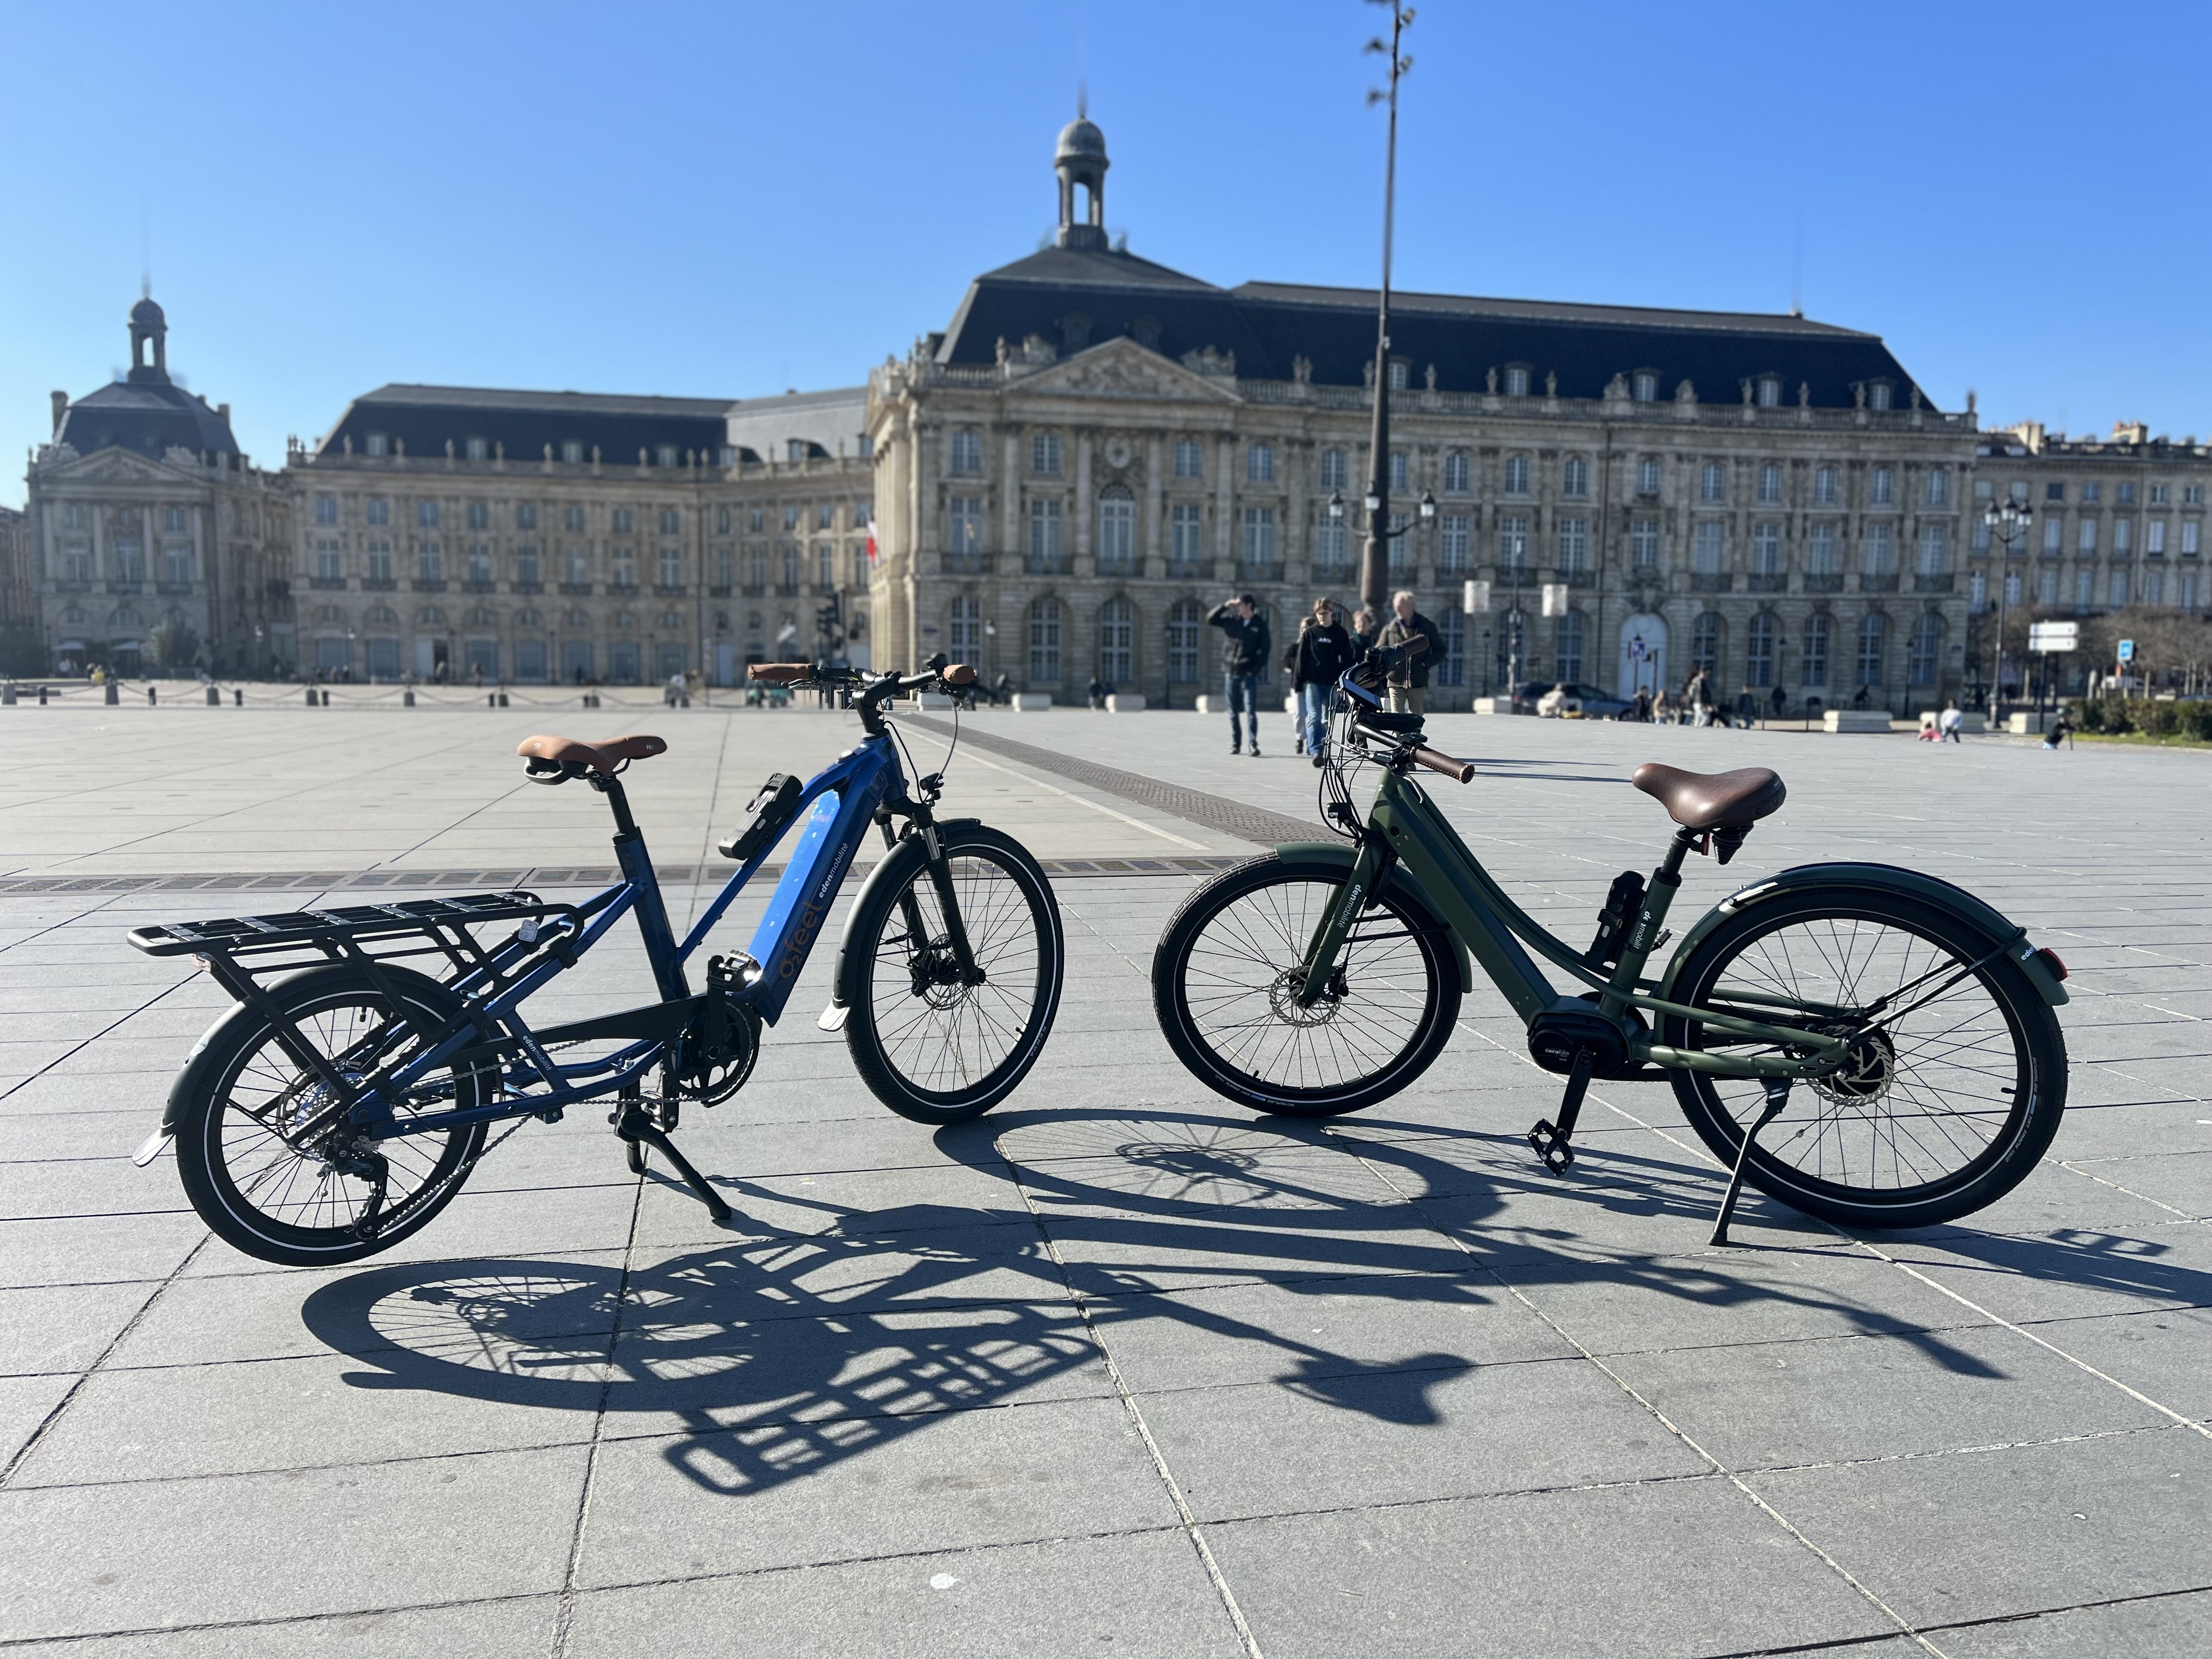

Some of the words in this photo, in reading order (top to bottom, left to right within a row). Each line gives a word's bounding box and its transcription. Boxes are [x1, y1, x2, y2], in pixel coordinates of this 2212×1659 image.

[819, 843, 849, 898] edenmobilité
[522, 1035, 553, 1071] edenmobilité
[1030, 1025, 1047, 1057] KENDA
